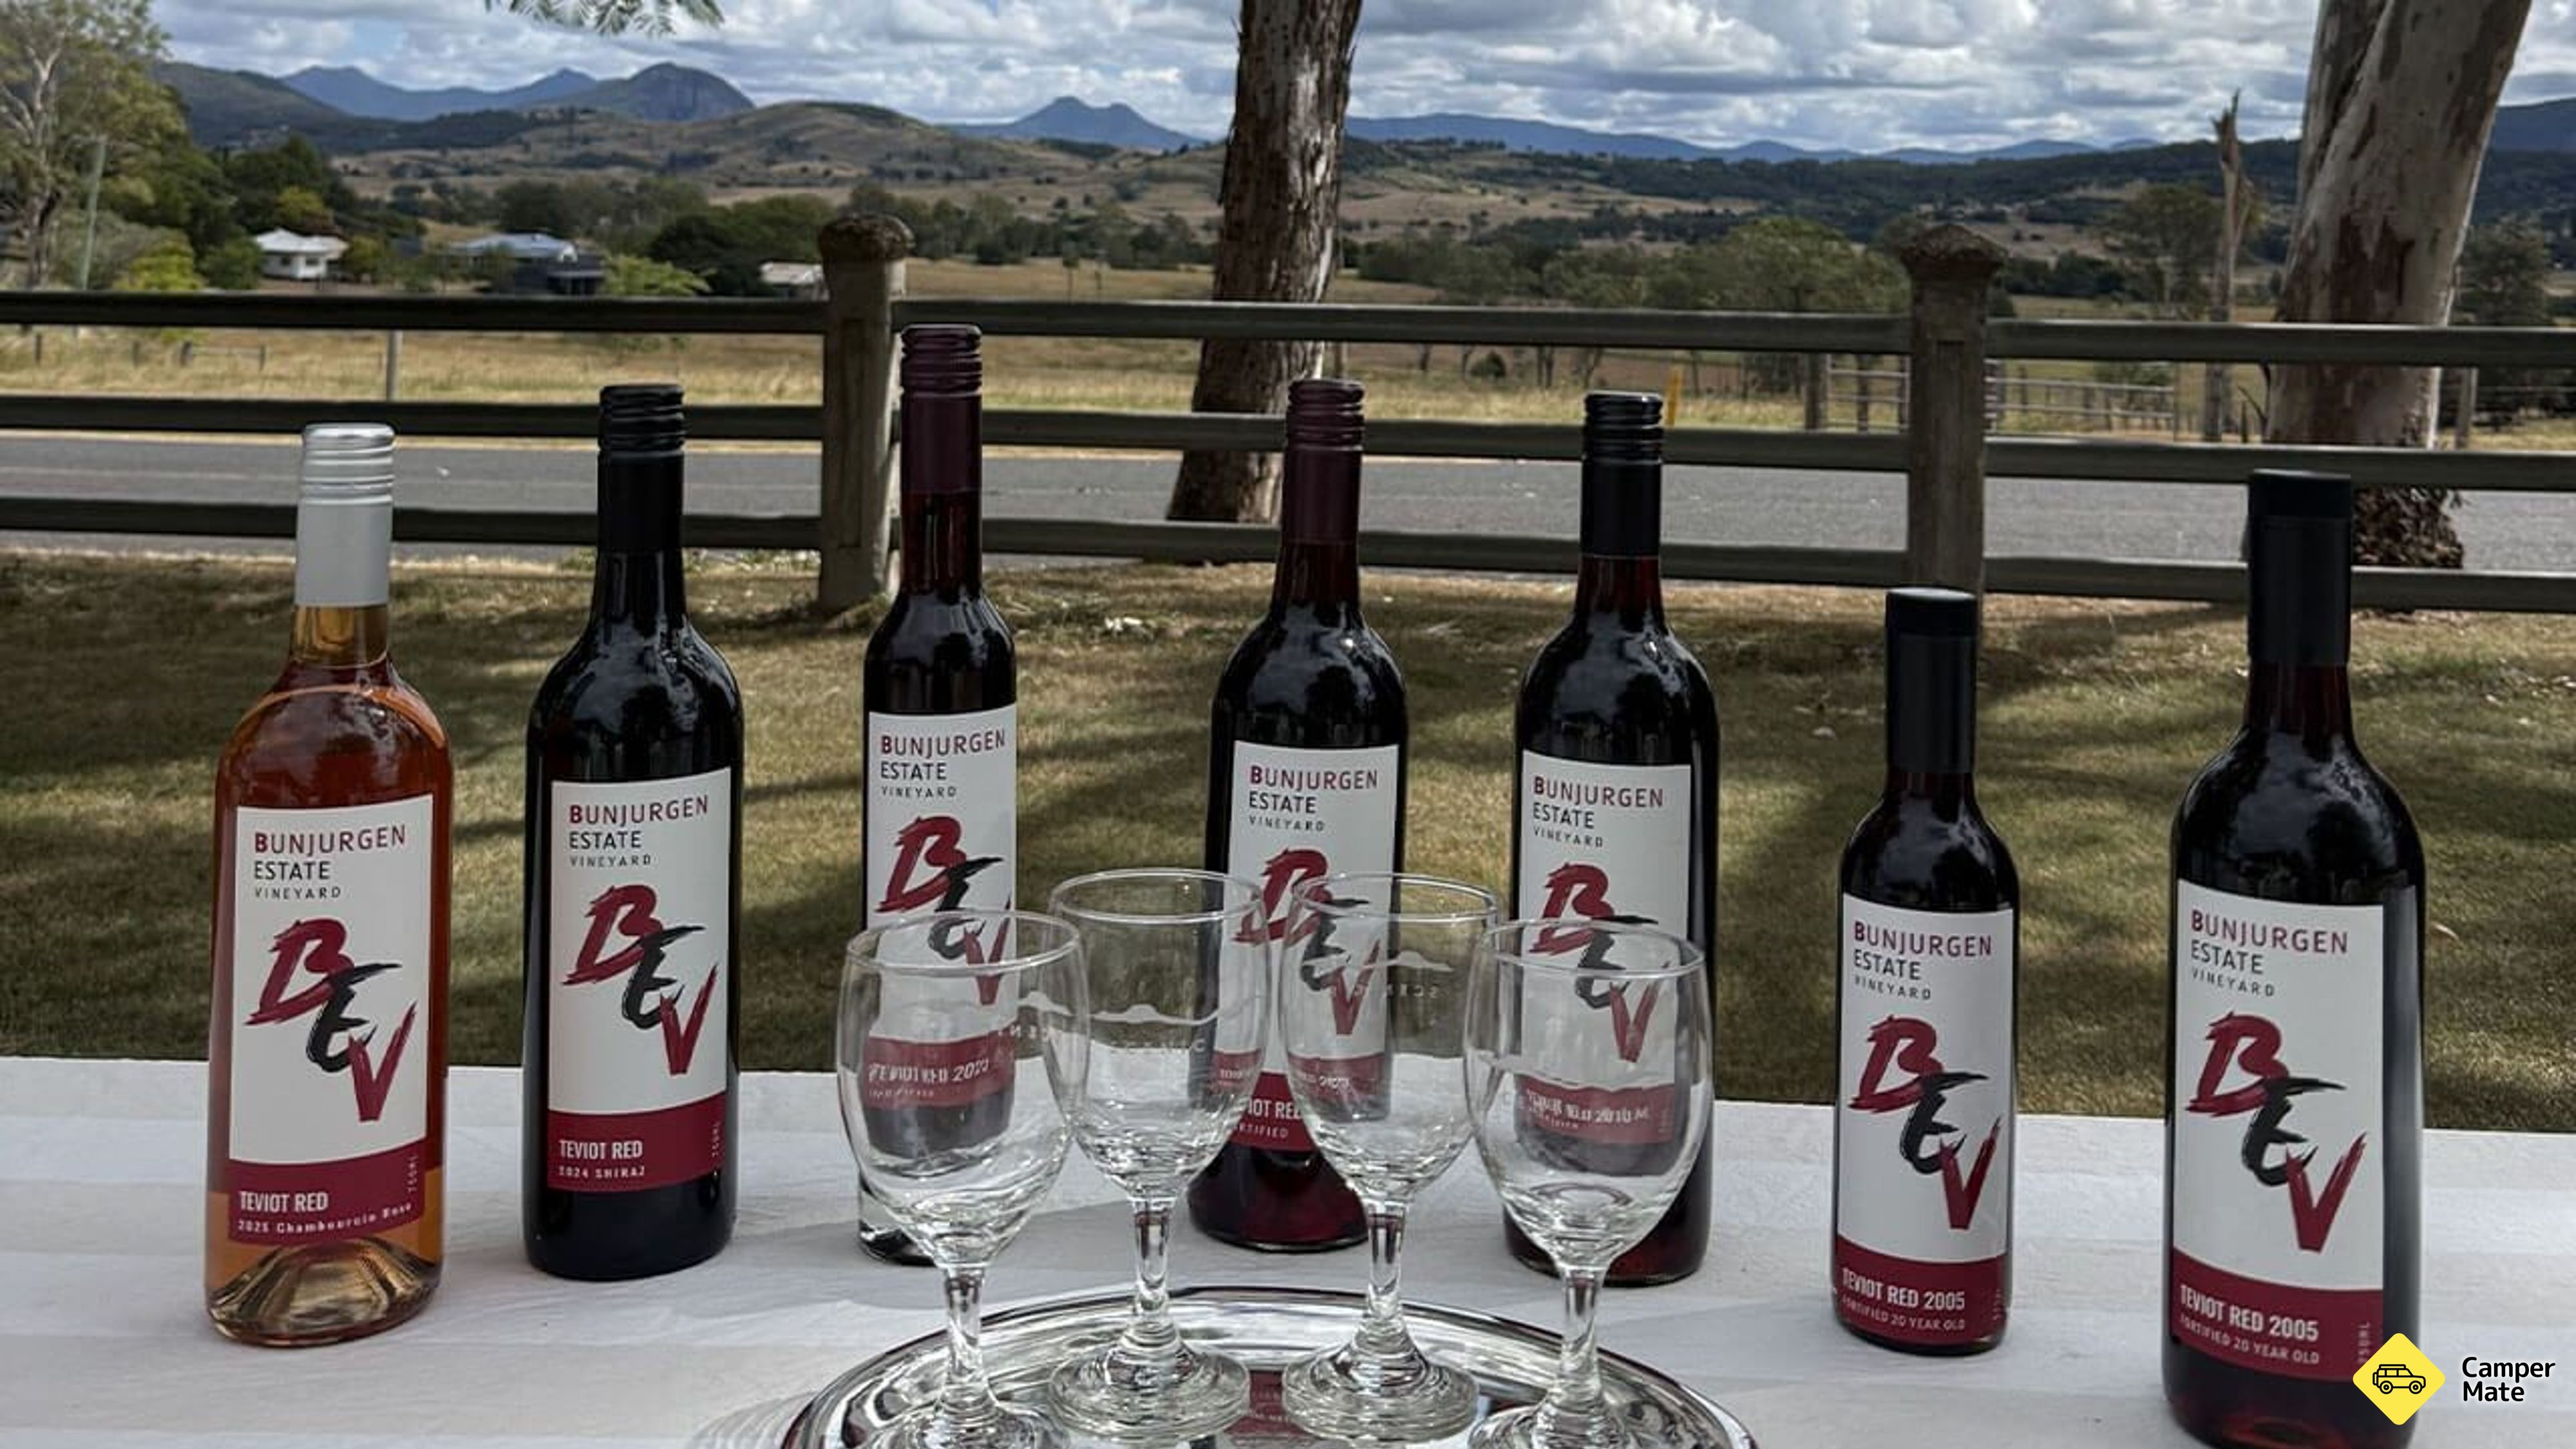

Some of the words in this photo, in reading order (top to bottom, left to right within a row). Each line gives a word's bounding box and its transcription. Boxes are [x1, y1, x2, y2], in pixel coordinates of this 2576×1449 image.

[881, 729, 1005, 759] BUNJURGEN
[881, 761, 947, 780] ESTATE
[1250, 765, 1378, 791] BUNJURGEN
[881, 786, 956, 798] VINEYARD
[1249, 791, 1316, 813] ESTATE
[1533, 776, 1663, 807] BUNJURGEN
[570, 795, 708, 828] BUNJURGEN
[1249, 815, 1325, 831] VINEYARD
[1533, 802, 1595, 829] ESTATE
[255, 824, 405, 857] BUNJURGEN
[569, 831, 641, 849] ESTATE
[1533, 826, 1603, 848] VINEYARD
[254, 860, 331, 880] ESTATE
[570, 854, 650, 867] VINEYARD
[255, 887, 341, 899] VINEYARD
[875, 816, 1011, 1006] BEV
[1854, 921, 1991, 956] BUNJURGEN
[2192, 909, 2348, 954] BUNJURGEN
[1530, 863, 1673, 1063] BEV
[1854, 949, 1921, 980] ESTATE
[2192, 939, 2264, 974] ESTATE
[562, 884, 717, 1075] BEV
[1855, 975, 1931, 999] VINEYARD
[2192, 967, 2275, 997] VINEYARD
[243, 918, 417, 1122] BEV
[1848, 1014, 2002, 1229] BEV
[2185, 1012, 2367, 1253] BEV
[559, 1139, 607, 1159] TEVIOT
[612, 1141, 643, 1159] RED
[559, 1166, 589, 1179] 2024
[595, 1166, 645, 1179] SHIRAZ
[239, 1191, 290, 1212] TEVIOT
[294, 1192, 328, 1212] RED
[1842, 1267, 1883, 1300] TEVIOT
[1887, 1285, 1918, 1308] RED
[1924, 1291, 1965, 1311] 2005
[1842, 1294, 1889, 1321] FORTIFIED
[1891, 1314, 1906, 1326] 20
[1909, 1317, 1941, 1330] YEAR
[1943, 1320, 1965, 1331] OLD
[2181, 1284, 2224, 1321] TEVIOT
[2229, 1305, 2263, 1332] RED
[2269, 1316, 2318, 1341] 2005
[2181, 1313, 2231, 1346] FORTIFIED
[2233, 1337, 2248, 1351] 20
[2253, 1343, 2289, 1360] YEAR
[2292, 1350, 2319, 1364] OLD
